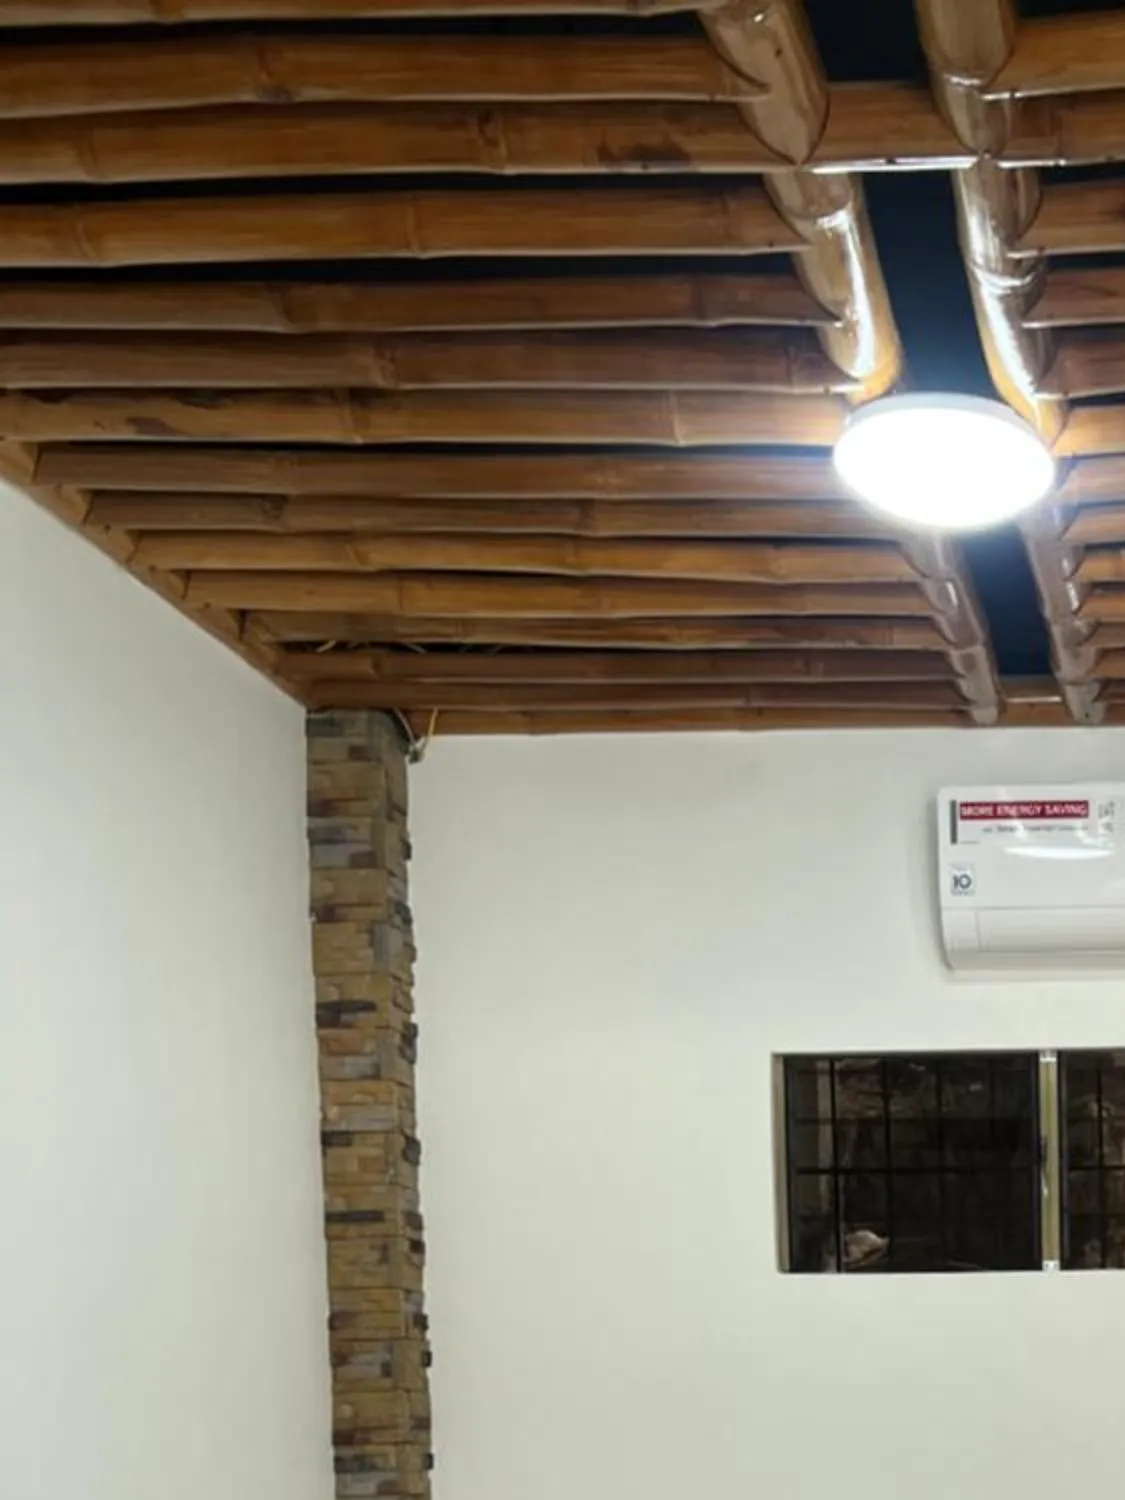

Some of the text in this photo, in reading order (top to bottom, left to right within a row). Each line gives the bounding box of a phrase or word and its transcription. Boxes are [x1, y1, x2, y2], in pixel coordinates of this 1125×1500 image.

[960, 803, 1088, 816] MORE ENERGY SAVING
[952, 873, 973, 889] 10
